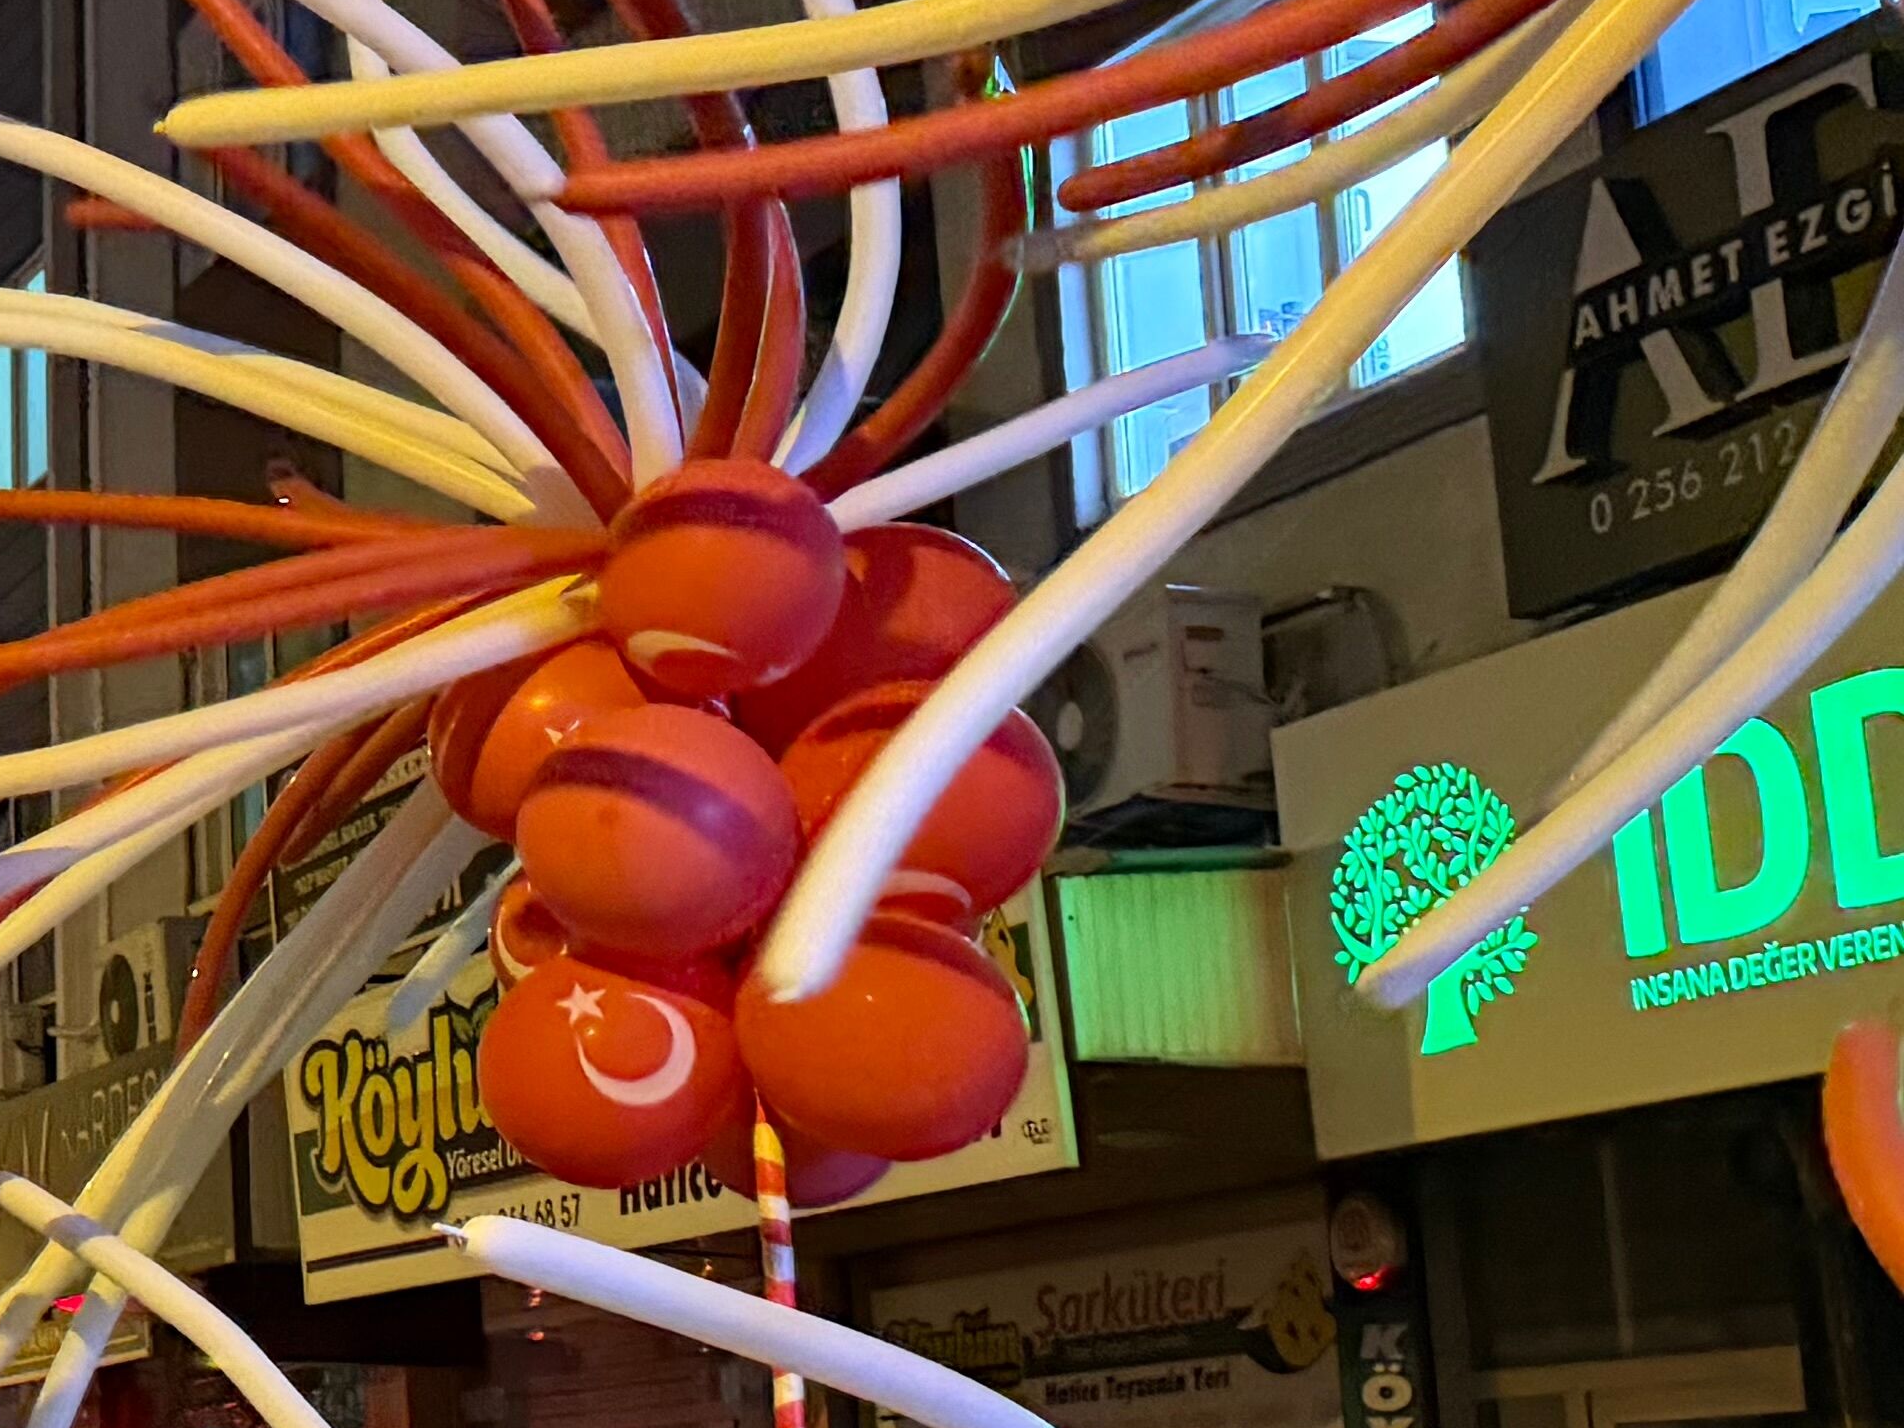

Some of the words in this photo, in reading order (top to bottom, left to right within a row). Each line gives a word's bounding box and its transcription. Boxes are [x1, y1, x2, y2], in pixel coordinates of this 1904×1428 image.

[1574, 239, 1743, 347] AHMET
[1591, 492, 1614, 534] 0
[1627, 460, 1702, 521] 256
